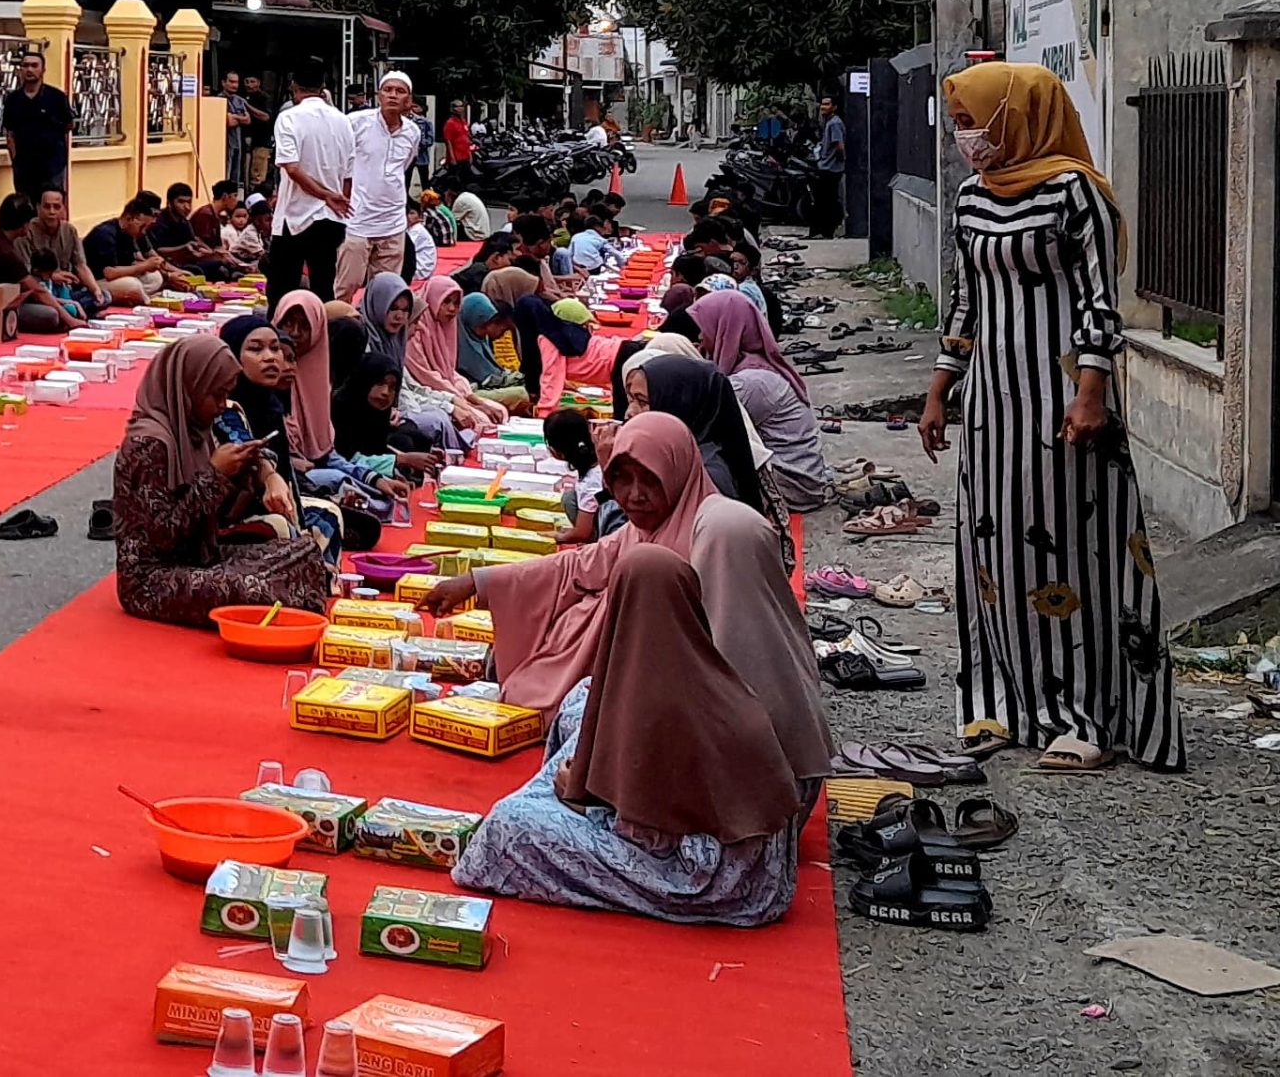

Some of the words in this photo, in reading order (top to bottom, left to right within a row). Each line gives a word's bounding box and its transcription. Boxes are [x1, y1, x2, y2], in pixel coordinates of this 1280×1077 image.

[935, 863, 973, 875] BEAR
[869, 904, 910, 921] BEAR
[930, 911, 973, 923] BEAR
[167, 1003, 221, 1023] MINAN
[358, 1051, 393, 1072] ANG
